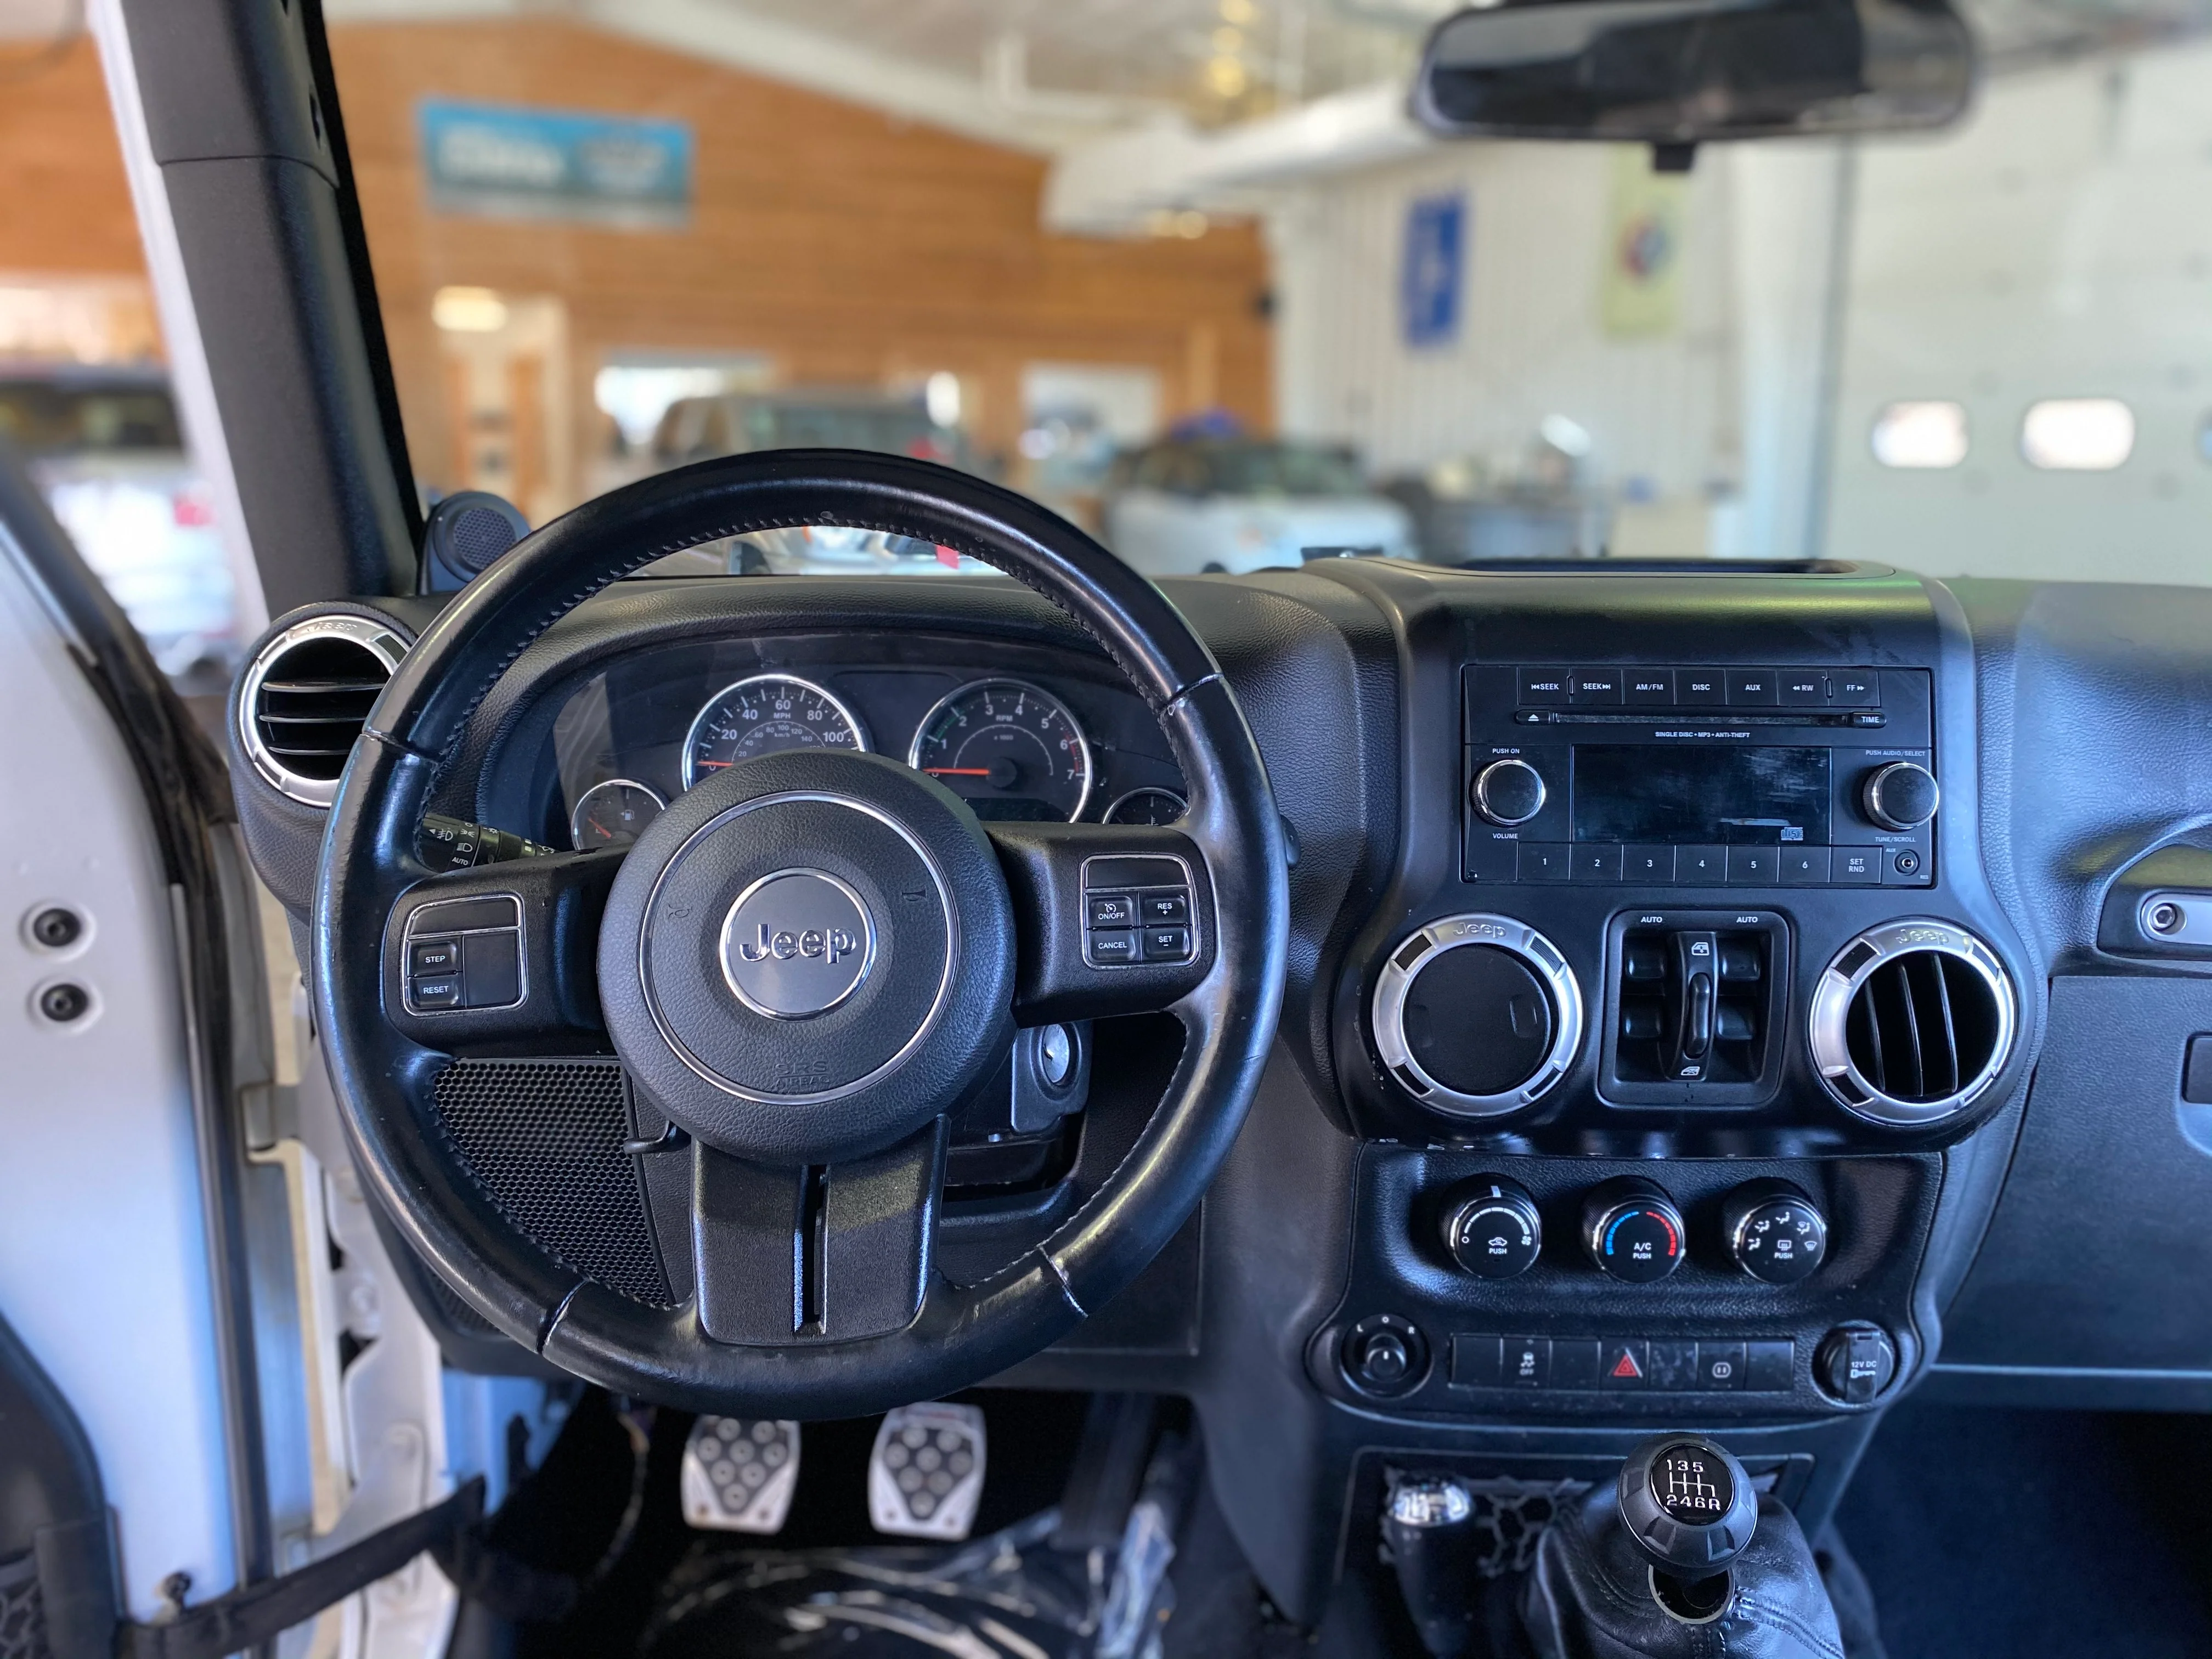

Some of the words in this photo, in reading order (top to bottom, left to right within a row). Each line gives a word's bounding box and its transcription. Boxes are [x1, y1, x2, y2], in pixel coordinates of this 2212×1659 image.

[775, 699, 791, 710] 60
[986, 704, 994, 715] 3
[1015, 704, 1023, 715] 4
[742, 709, 758, 720] 40
[807, 710, 822, 720] 80
[960, 716, 967, 726] 2
[1041, 719, 1049, 729] 5
[721, 729, 737, 740] 20
[823, 732, 844, 742] 100
[940, 739, 947, 749] 1
[1060, 740, 1068, 750] 6
[1067, 770, 1075, 780] 7
[452, 856, 468, 866] AUTO
[1594, 859, 1600, 867] 2
[1646, 859, 1653, 867] 3
[1699, 860, 1705, 868] 4
[1750, 860, 1757, 869] 5
[1802, 861, 1808, 869] 6
[1098, 912, 1125, 920] ON/OFF
[1453, 922, 1506, 939] Jeep
[1895, 929, 1949, 945] Jeep
[739, 923, 857, 964] Jeep
[425, 955, 445, 963] STEP
[423, 985, 449, 994] RESET
[1634, 1243, 1651, 1251] A/C
[1357, 1323, 1363, 1332] L
[1667, 1459, 1672, 1470] 1
[1678, 1460, 1689, 1471] 3
[1692, 1462, 1703, 1472] 5
[1666, 1494, 1677, 1506] 2
[1680, 1496, 1692, 1507] 4
[1695, 1497, 1706, 1508] 6
[1708, 1498, 1720, 1511] R
